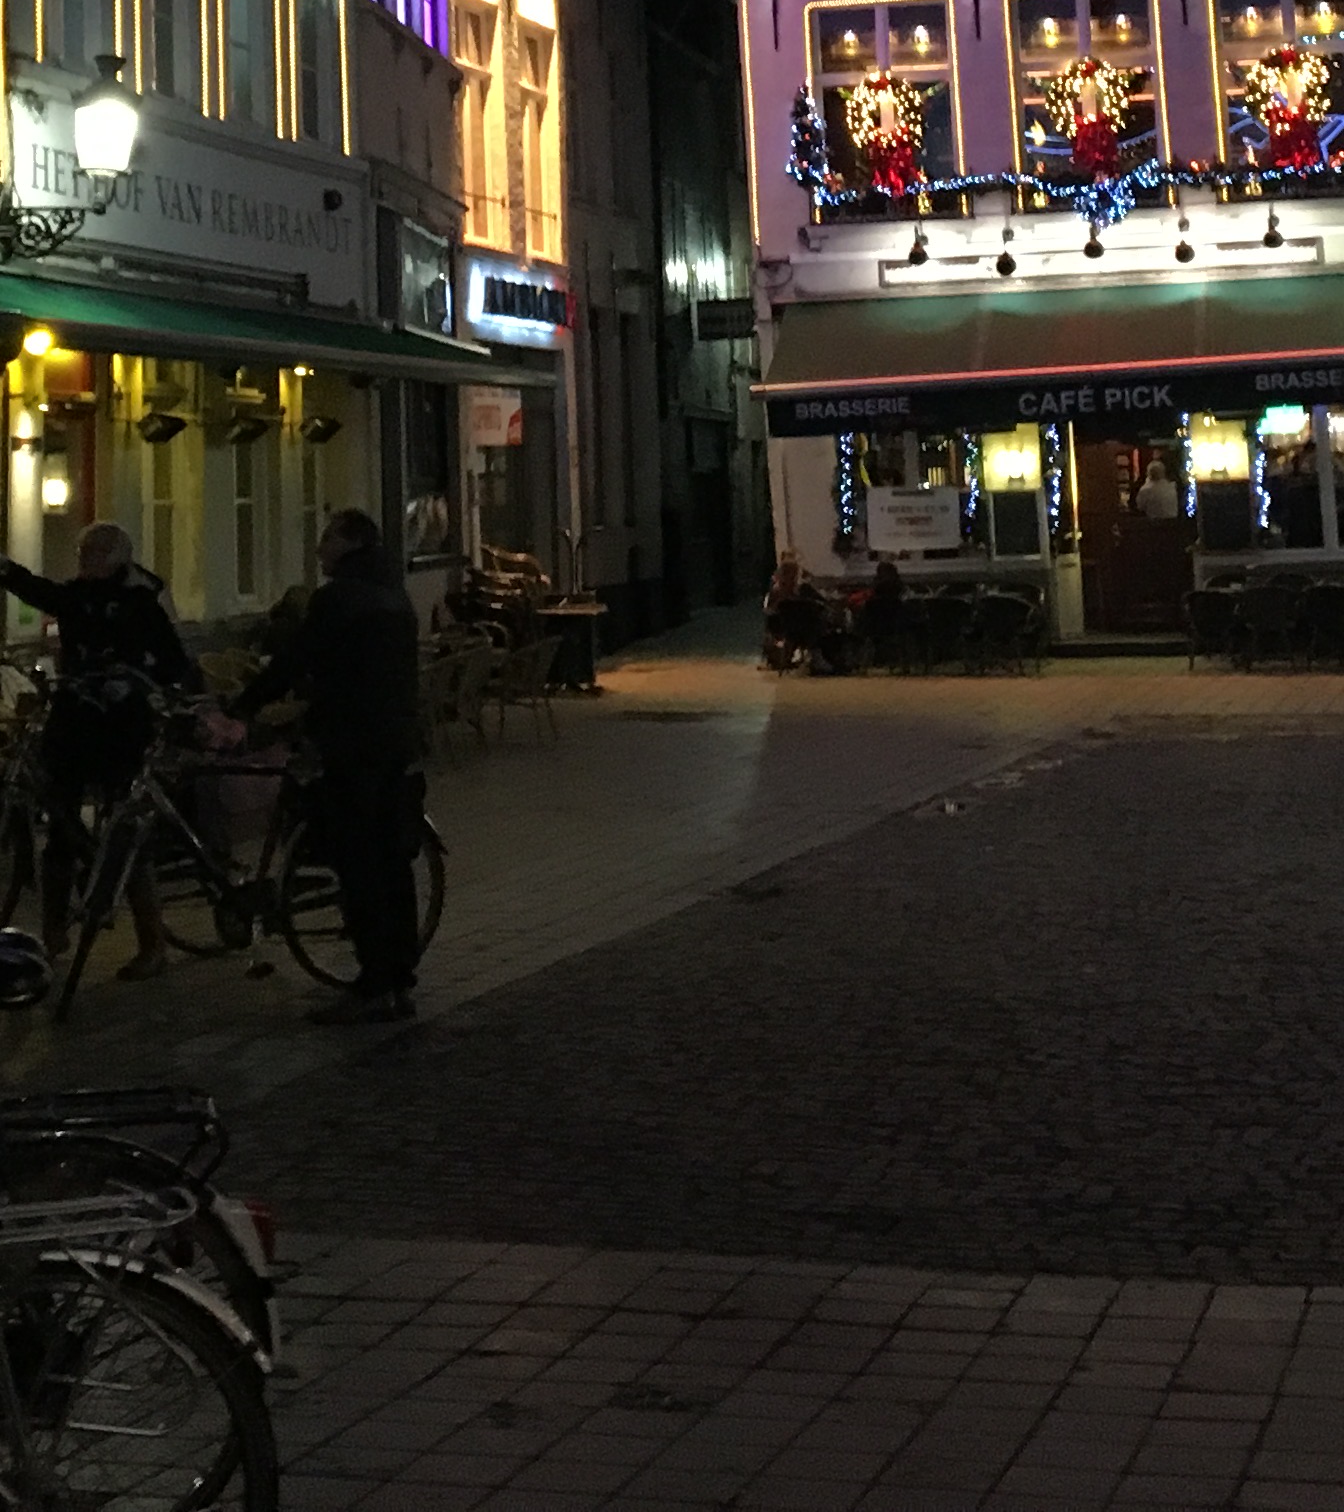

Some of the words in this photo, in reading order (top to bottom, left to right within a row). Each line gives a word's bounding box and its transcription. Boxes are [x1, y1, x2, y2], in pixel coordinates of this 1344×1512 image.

[32, 144, 81, 199] HET
[155, 175, 203, 225] VAN
[211, 189, 353, 255] REMBRANDT
[795, 396, 911, 421] BRASSERIE
[1018, 385, 1096, 416] CAFÉ
[1104, 384, 1174, 411] PICK
